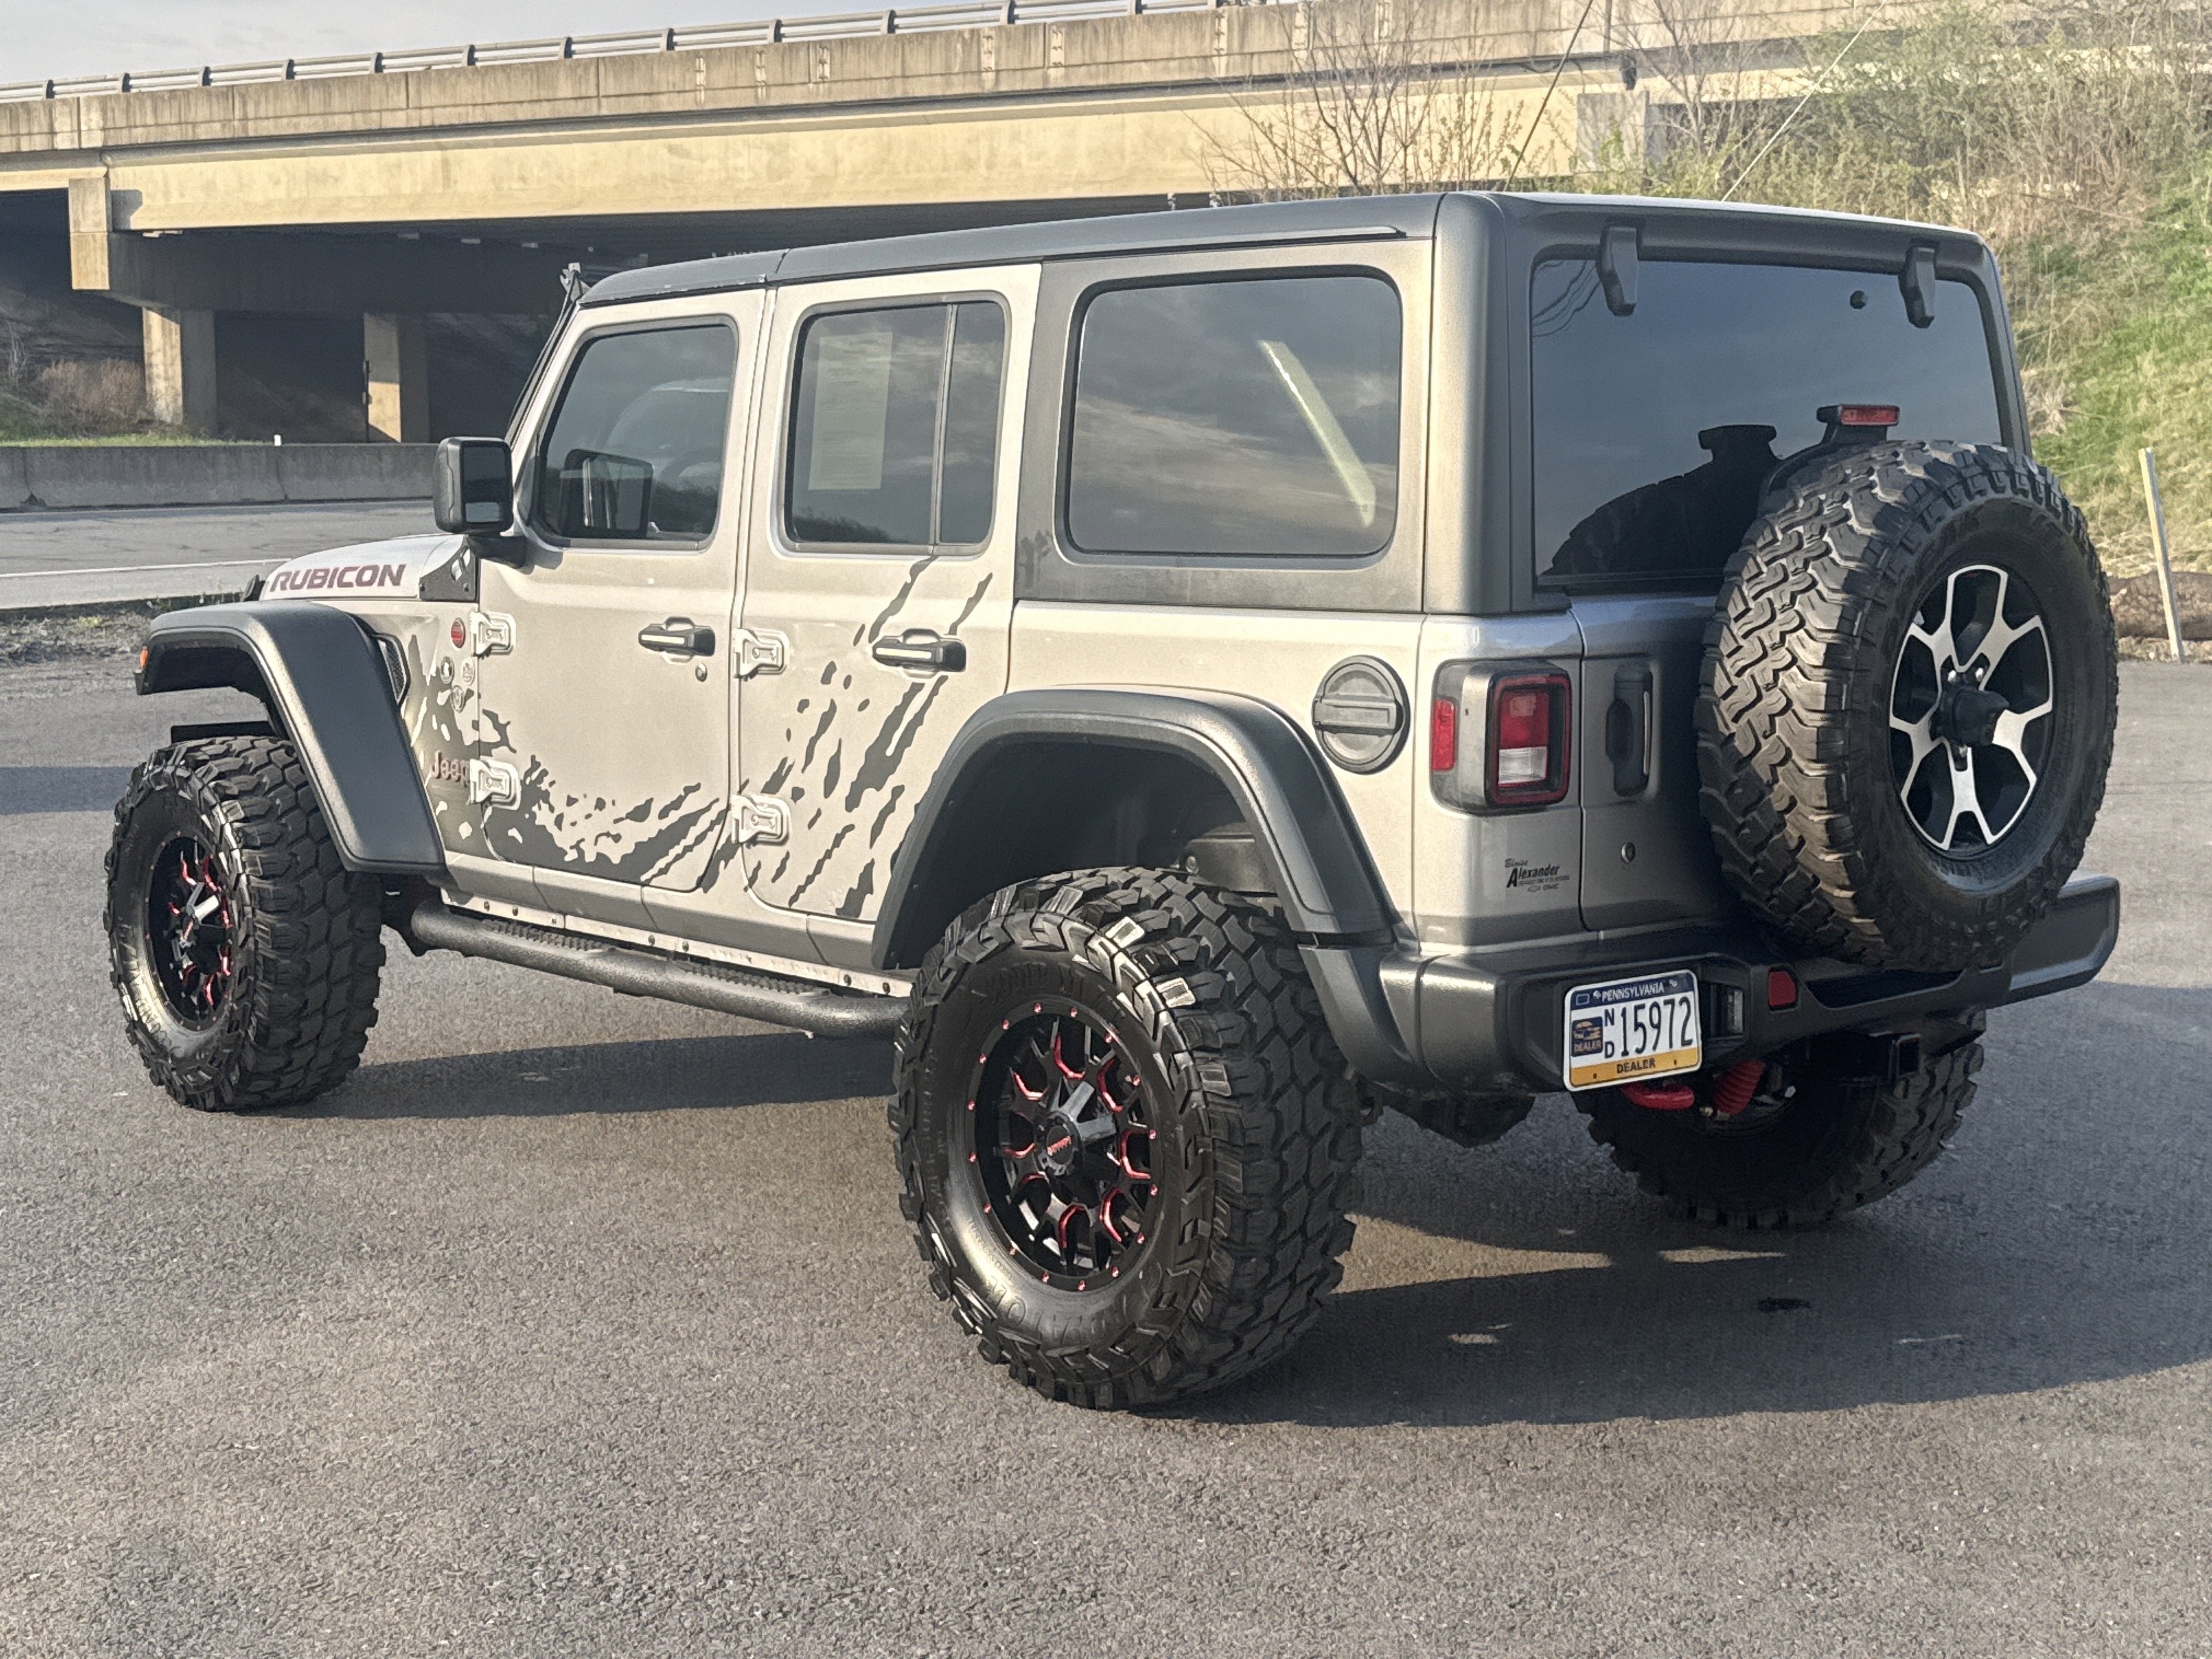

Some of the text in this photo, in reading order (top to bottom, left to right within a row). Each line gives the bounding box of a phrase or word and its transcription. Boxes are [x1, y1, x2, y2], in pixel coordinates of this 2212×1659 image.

[269, 563, 407, 592] RUBICON
[1506, 863, 1560, 888] Alexander
[1601, 982, 1665, 1002] PENNSYLVANIA
[1604, 996, 1694, 1058] N D 15972
[1616, 1057, 1656, 1074] DEALER
